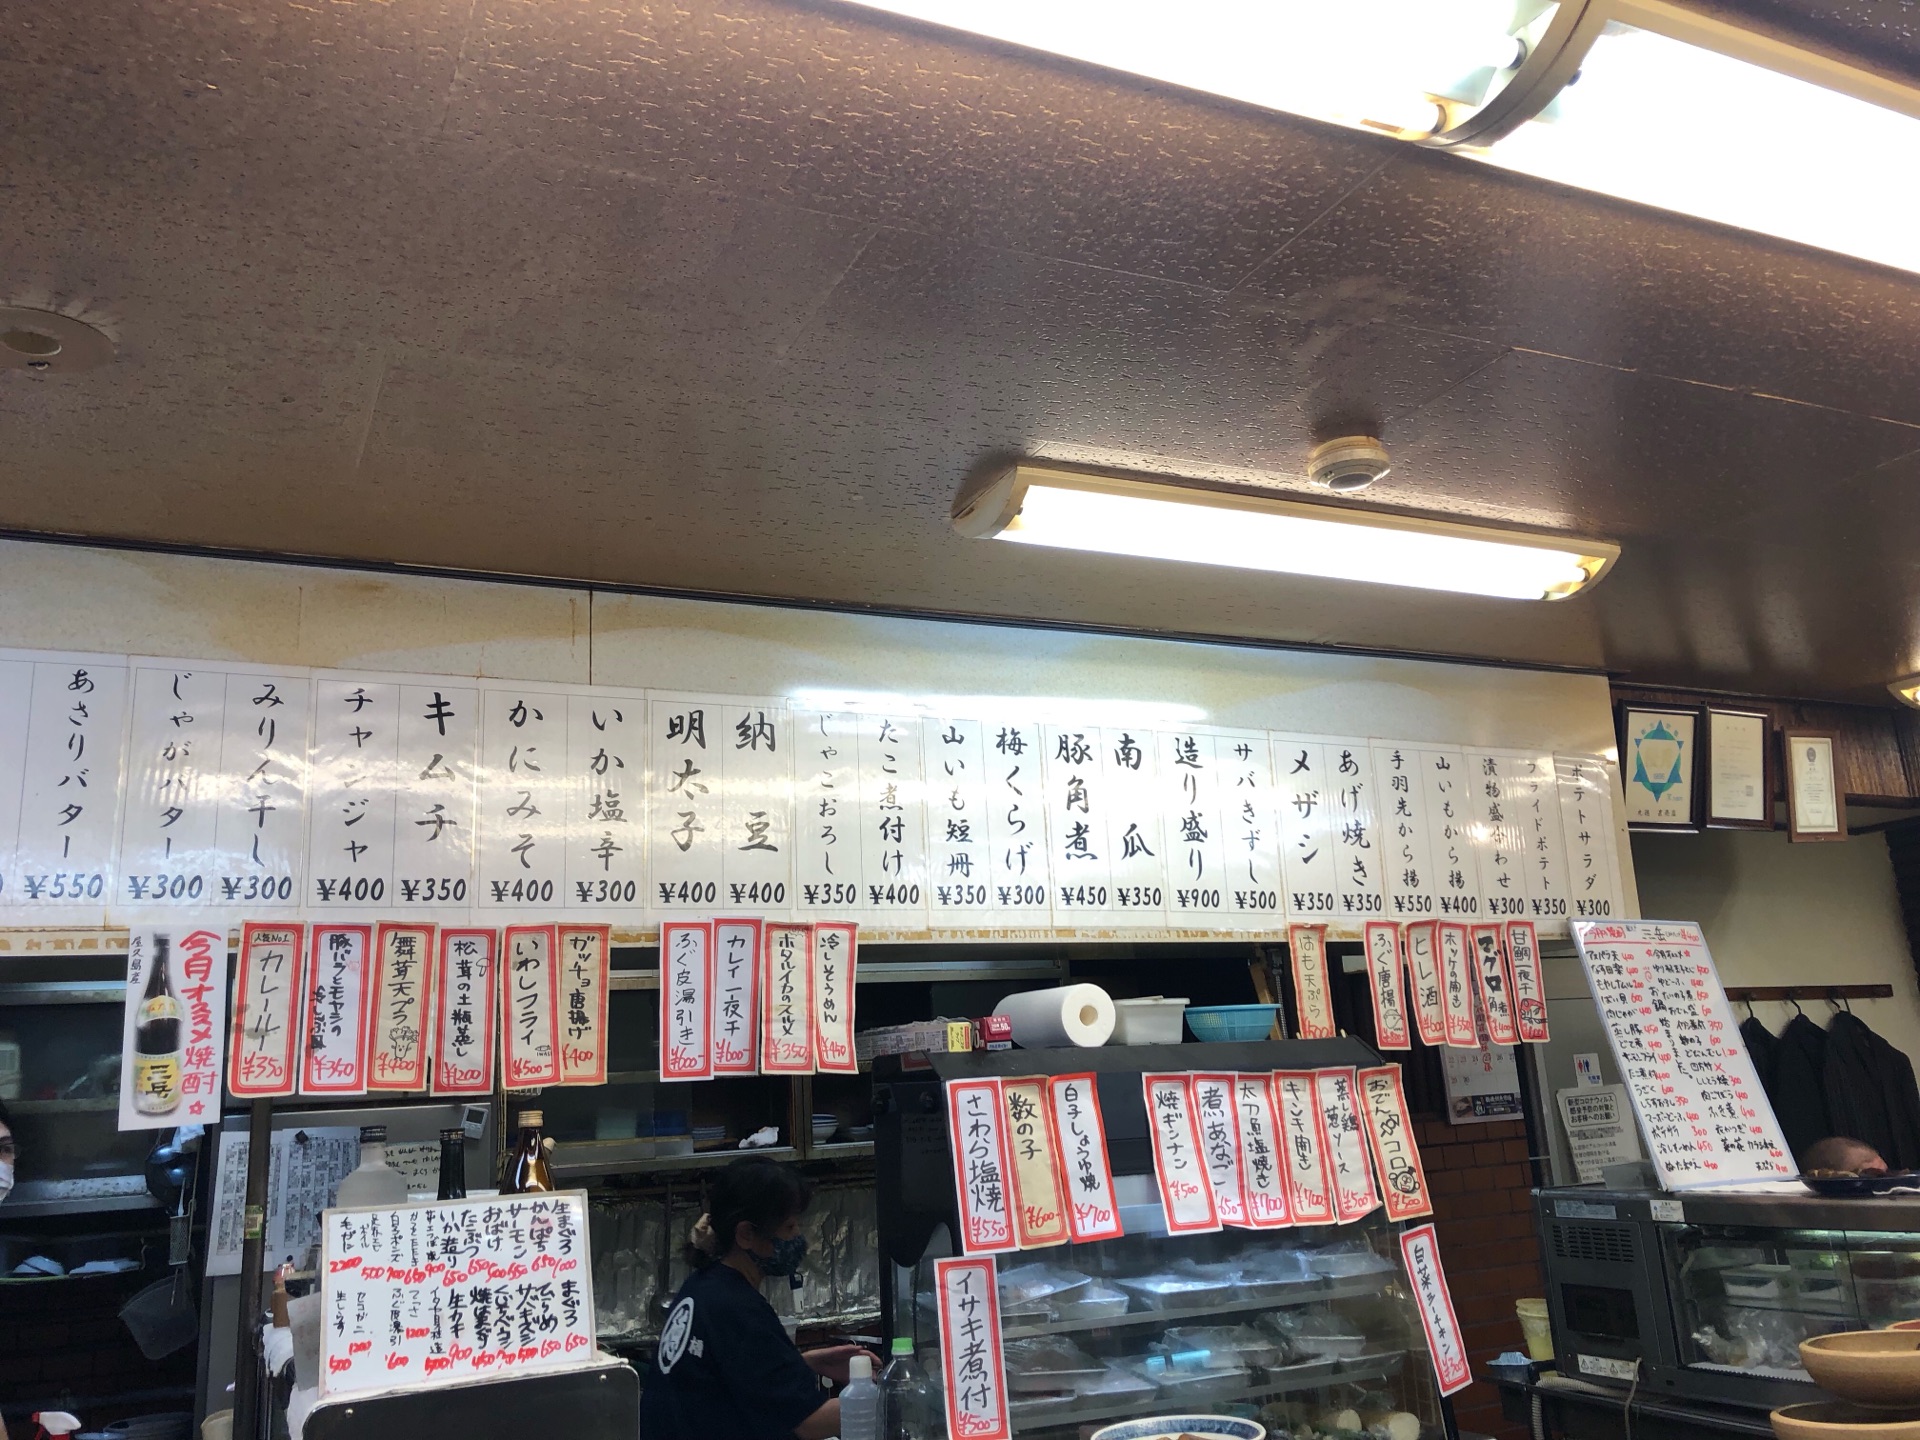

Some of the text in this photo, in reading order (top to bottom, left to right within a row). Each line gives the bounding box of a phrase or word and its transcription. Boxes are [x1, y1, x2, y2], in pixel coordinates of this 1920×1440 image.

[58, 669, 95, 858] あさりバター
[159, 673, 194, 859] じゃがバター
[247, 684, 284, 867] みりん干し
[342, 688, 374, 863] チャンジャ
[414, 692, 457, 842] キムチ
[506, 700, 544, 869] かにみそ
[588, 708, 628, 872] いか塩辛
[666, 710, 709, 852] 明太子
[735, 712, 779, 852] 納豆
[817, 714, 838, 876] じゃこおろし
[878, 719, 906, 877] たこ煮付け
[942, 726, 974, 878] 山いも短冊
[996, 727, 1034, 876] 梅くらげ
[1055, 734, 1098, 861] 豚角煮
[1114, 733, 1155, 860] 南瓜
[1174, 737, 1208, 881] 造り盛り
[1233, 743, 1261, 884] サバきずし
[1289, 750, 1319, 865] メザシ
[1338, 750, 1371, 887] あげ焼き
[1390, 750, 1420, 889] 手羽先から揚
[1435, 756, 1465, 890] 山いもから揚
[1482, 757, 1512, 889] 漬物盛合わせ
[1528, 761, 1551, 891] フライドポテト
[1571, 763, 1598, 891] ポテトサラダ
[24, 874, 103, 899] ¥550
[128, 874, 204, 899] ¥300
[221, 876, 292, 900] ¥300
[316, 877, 385, 901] ¥400
[401, 878, 467, 902] ¥350
[490, 880, 554, 903] ¥400
[576, 880, 636, 903] ¥300
[659, 881, 716, 904] ¥400
[730, 882, 785, 904] ¥400
[804, 883, 856, 905] ¥350
[869, 883, 920, 905] ¥400
[938, 885, 986, 905] ¥350
[998, 885, 1045, 906] ¥300
[1061, 886, 1107, 906] ¥450
[1118, 887, 1162, 908] ¥350
[1177, 889, 1220, 909] ¥900
[1235, 890, 1276, 910] ¥500
[1293, 893, 1334, 911] ¥350
[1342, 894, 1382, 912] ¥350
[1394, 895, 1432, 913] ¥550
[1440, 896, 1478, 914] ¥400
[1489, 896, 1524, 915] ¥300
[1532, 897, 1567, 916] ¥350
[1576, 899, 1610, 916] ¥300
[129, 936, 144, 985] 屋久島産
[329, 934, 352, 1037] 豚バラとモヤシの
[388, 932, 417, 1025] 舞茸天プラ
[723, 935, 746, 1037] カレイ一夜干
[778, 933, 796, 1036] ホタルイカのスルメ
[820, 933, 840, 1023] 冷しそうめん
[1300, 935, 1320, 1018] はも天ぷら
[1375, 934, 1395, 1008] ふぐ唐揚
[1416, 937, 1438, 1007] ヒレ酒
[1445, 932, 1461, 1008] ホッケの開き
[1511, 930, 1534, 995] 甘鯛一夜干
[255, 950, 283, 1051] カレールー
[451, 940, 478, 1057] 松茸の土瓶蒸し
[516, 940, 540, 1046] いわしフライ
[568, 936, 595, 1040] ガッチョ唐揚げ
[675, 933, 697, 1046] ふぐ皮湯引き
[1606, 1009, 1638, 1019] 肉じゃが
[242, 1052, 283, 1082] ¥350
[444, 1062, 481, 1085] ¥1200
[562, 1044, 593, 1070] ¥400
[1367, 1079, 1393, 1115] おでん
[1008, 1092, 1042, 1160] 数の子
[1065, 1083, 1100, 1192] 白子しょうゆ焼
[1156, 1091, 1188, 1170] 焼ギンナン
[1201, 1086, 1234, 1186] 煮あなご
[1239, 1083, 1272, 1189] 太刀魚塩焼き
[1285, 1081, 1312, 1171] キンキ開き
[1691, 1126, 1707, 1136] 300
[1697, 1141, 1713, 1152] 450
[967, 1094, 1005, 1212] さわら塩焼
[1383, 1140, 1407, 1169] コロ
[1170, 1180, 1198, 1200] ¥500
[1250, 1190, 1283, 1217] ¥700
[1392, 1192, 1420, 1210] ¥500
[440, 1211, 461, 1268] いか造り
[461, 1209, 482, 1258] たこぶつ
[483, 1207, 508, 1252] おばけ
[506, 1203, 528, 1259] サーモン
[530, 1201, 553, 1252] かんぱち
[551, 1199, 576, 1255] 生まぐろ
[1075, 1203, 1110, 1231] ¥700
[443, 1270, 468, 1287] 650
[468, 1258, 490, 1276] 650
[531, 1254, 555, 1272] 650
[333, 1291, 346, 1337] 生しらす
[408, 1290, 421, 1318] てっさ
[448, 1288, 467, 1338] 生カキ
[561, 1280, 580, 1327] まぐろ
[449, 1343, 472, 1369] 900
[541, 1339, 561, 1358] 650
[565, 1332, 588, 1352] 650
[956, 1272, 991, 1411] イサキ煮付
